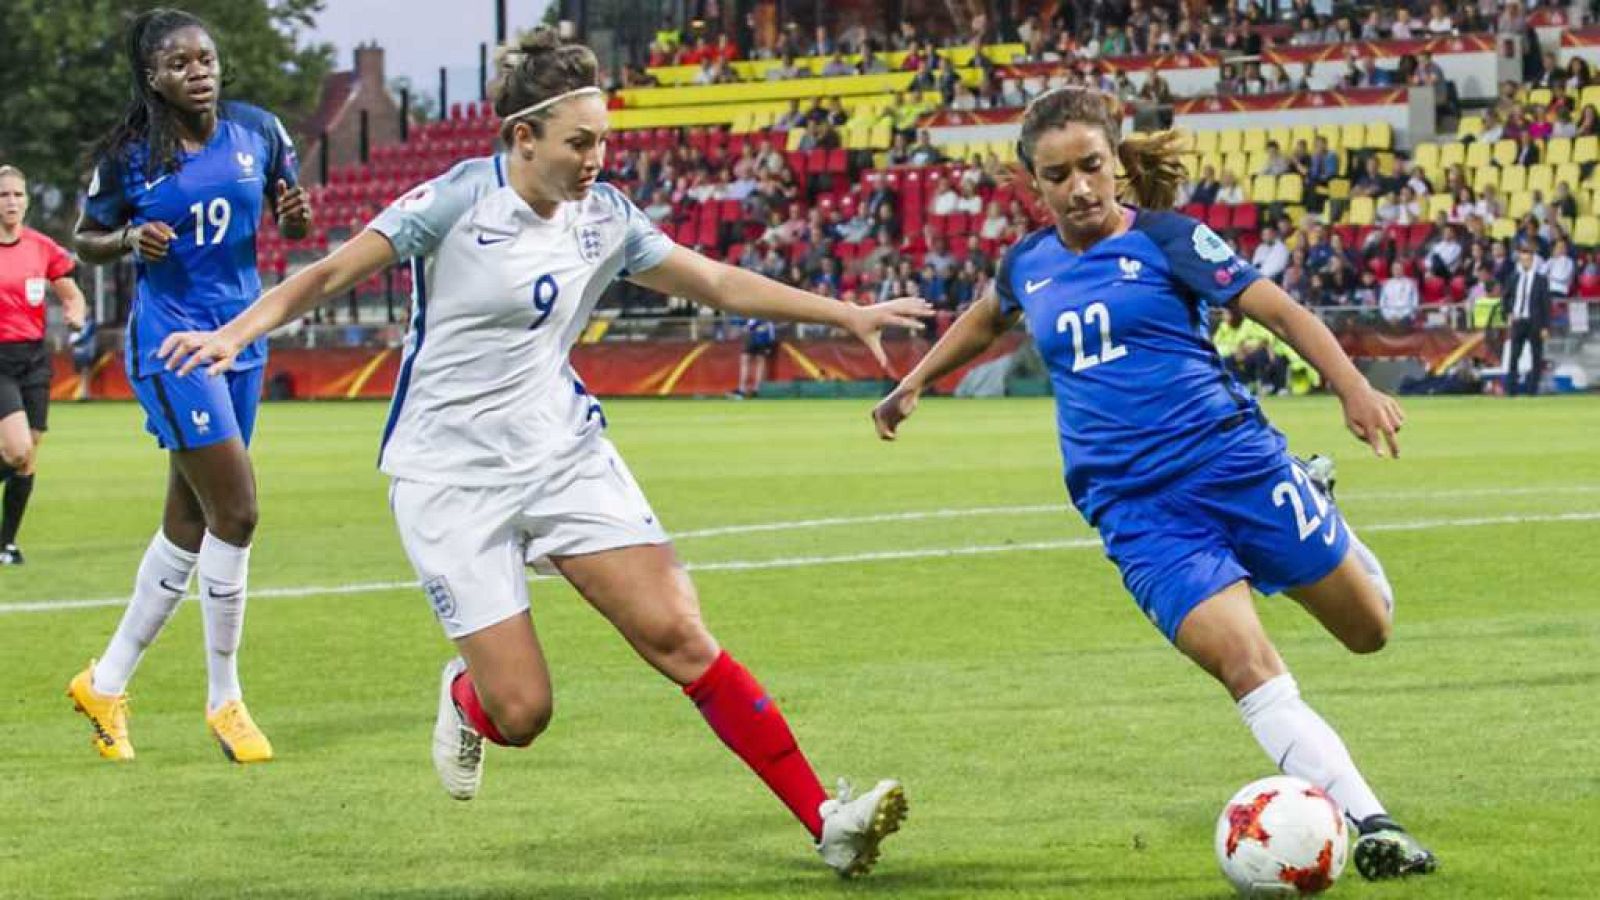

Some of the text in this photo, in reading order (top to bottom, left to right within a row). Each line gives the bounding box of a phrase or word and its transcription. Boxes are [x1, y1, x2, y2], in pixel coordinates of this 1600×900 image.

[190, 198, 232, 246] 19
[528, 274, 559, 330] 9
[1056, 302, 1128, 373] 22
